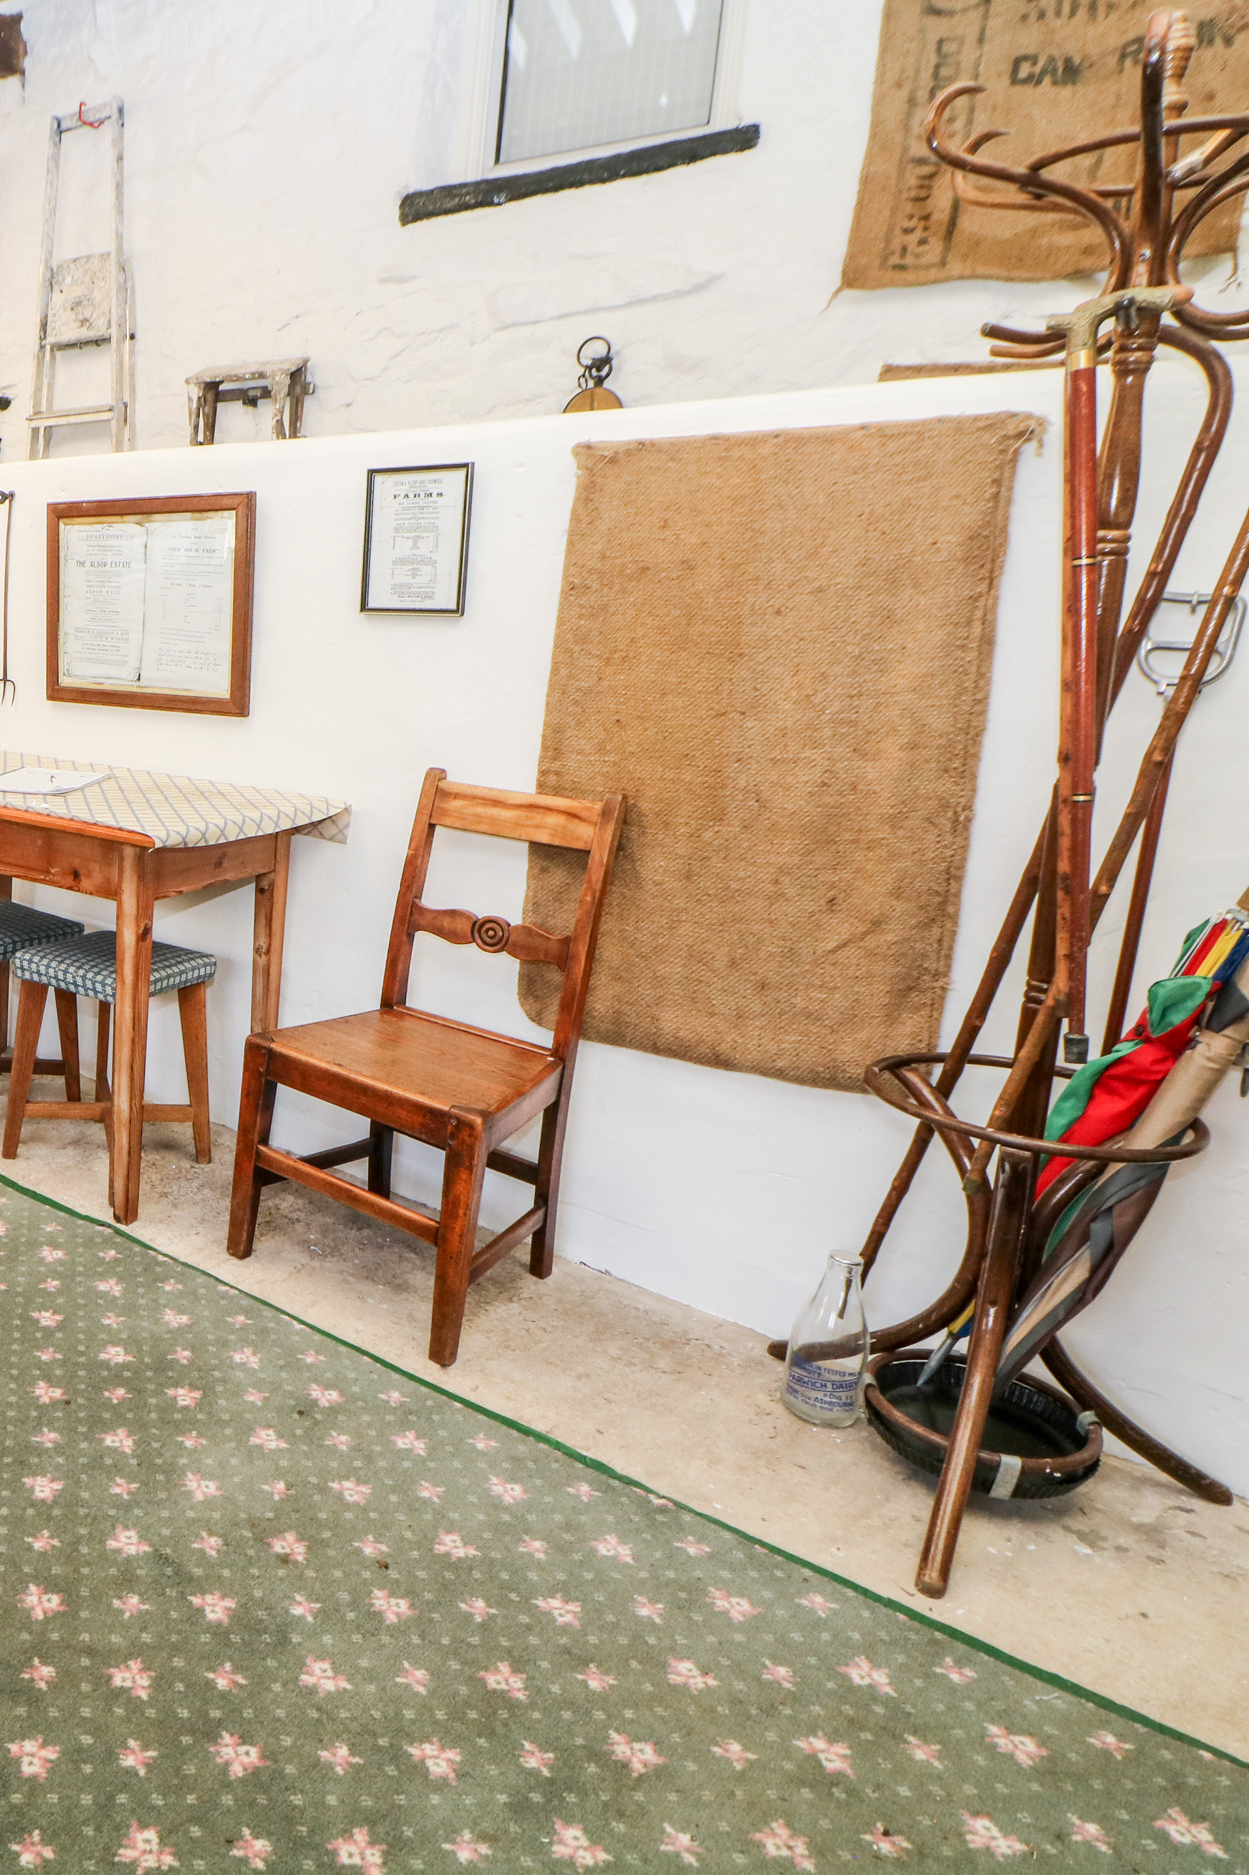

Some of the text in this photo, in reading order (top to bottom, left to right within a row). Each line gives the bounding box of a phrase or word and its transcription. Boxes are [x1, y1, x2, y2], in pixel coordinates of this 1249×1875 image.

[75, 560, 87, 568] THE
[110, 560, 133, 569] ESTATE
[789, 1371, 858, 1391] PARWICH DAIRY
